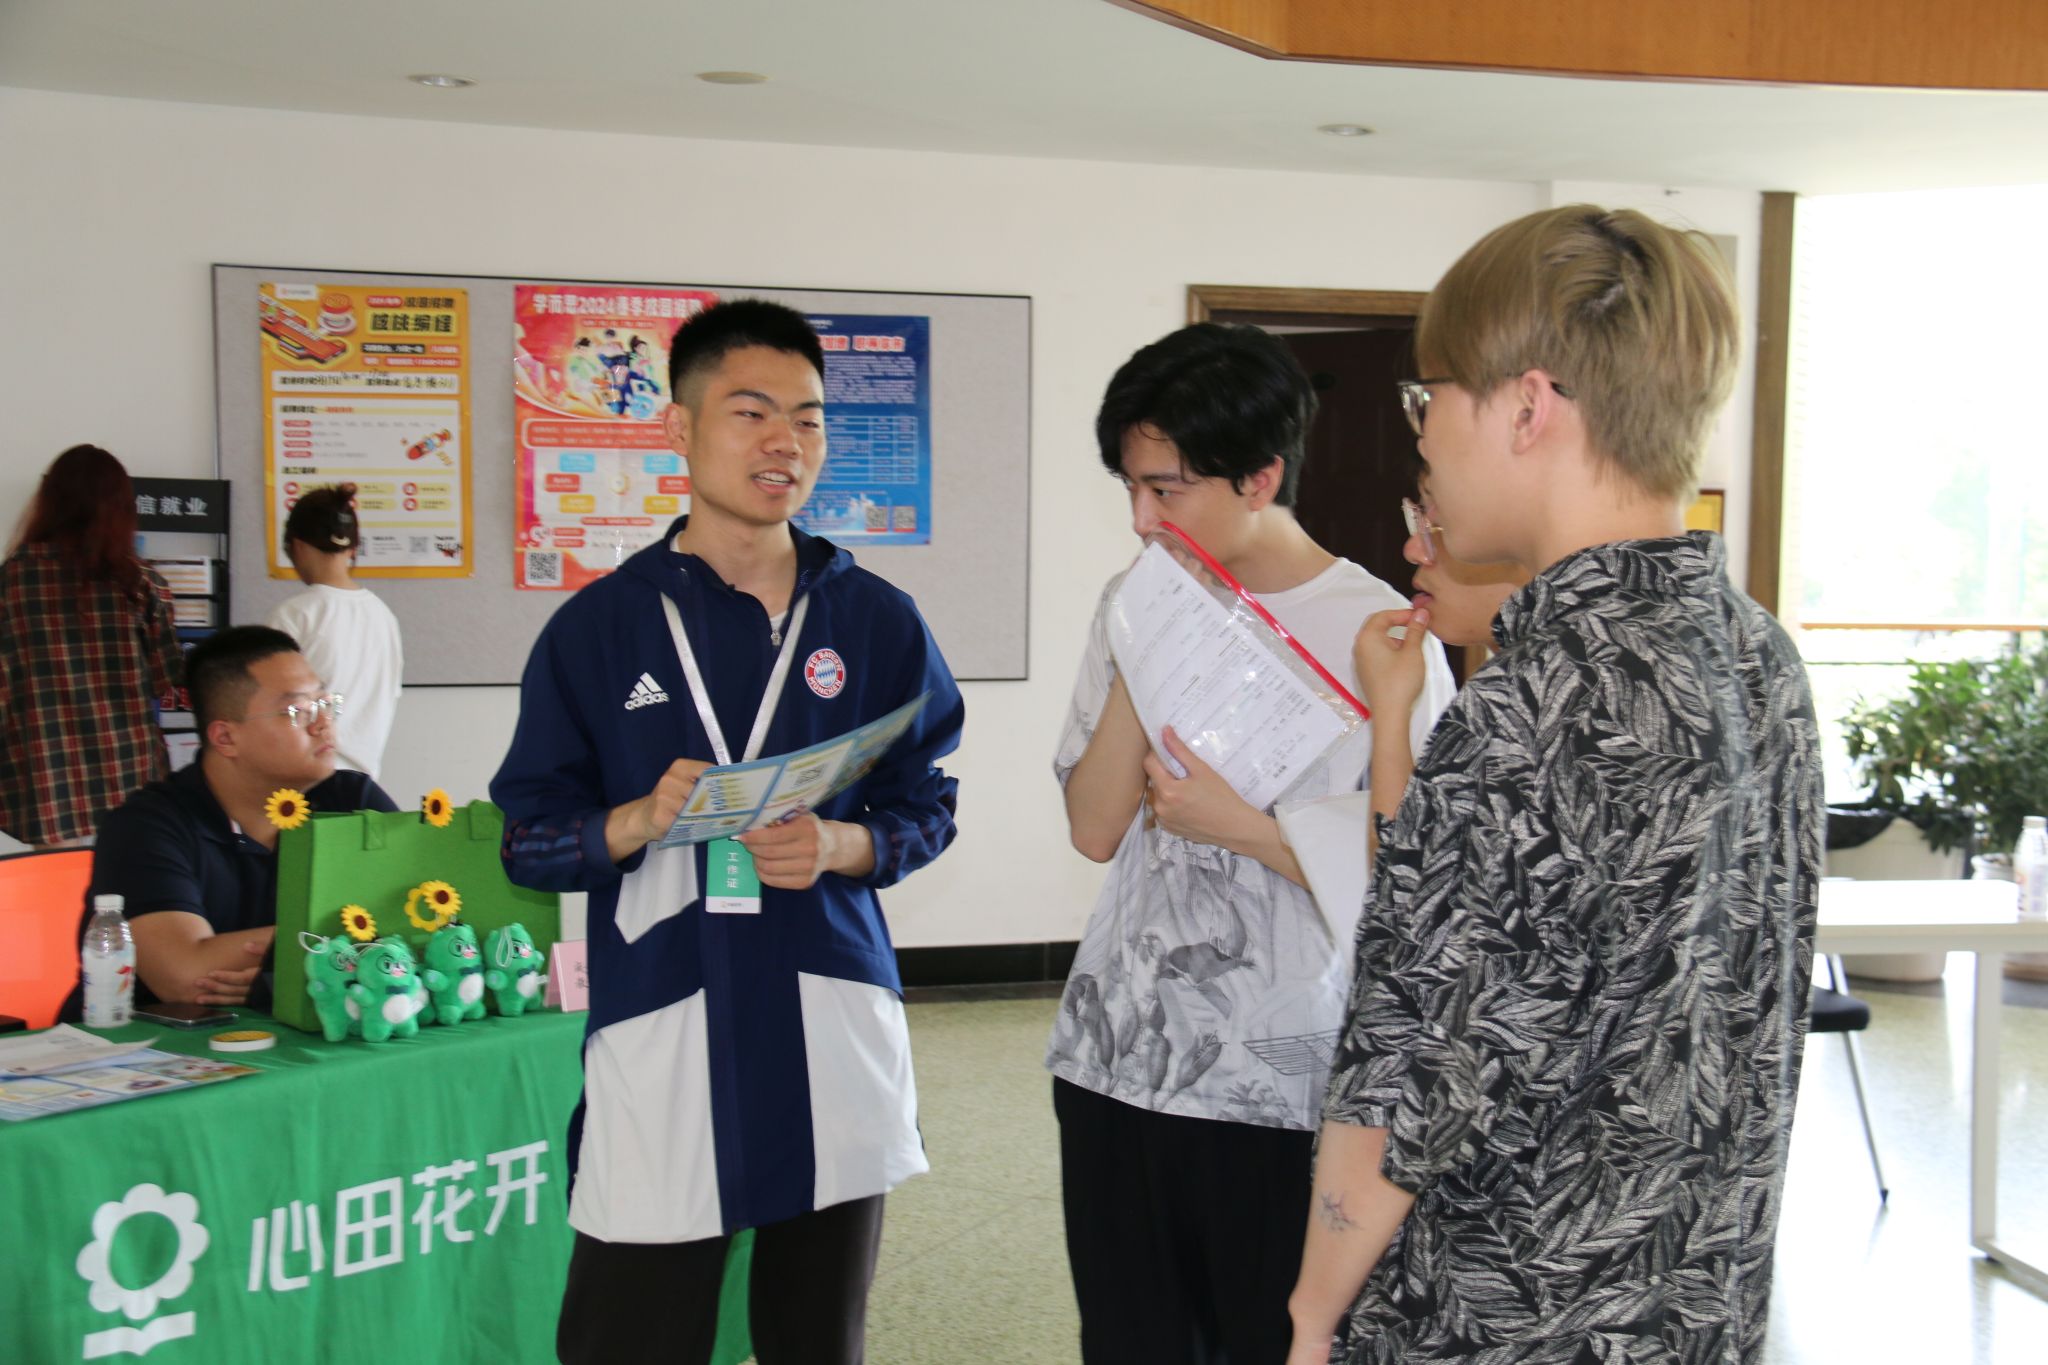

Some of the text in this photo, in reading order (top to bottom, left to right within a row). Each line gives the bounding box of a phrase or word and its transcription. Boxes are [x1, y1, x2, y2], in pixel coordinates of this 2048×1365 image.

[624, 691, 670, 711] adidas
[248, 1140, 549, 1292] 心田花开
